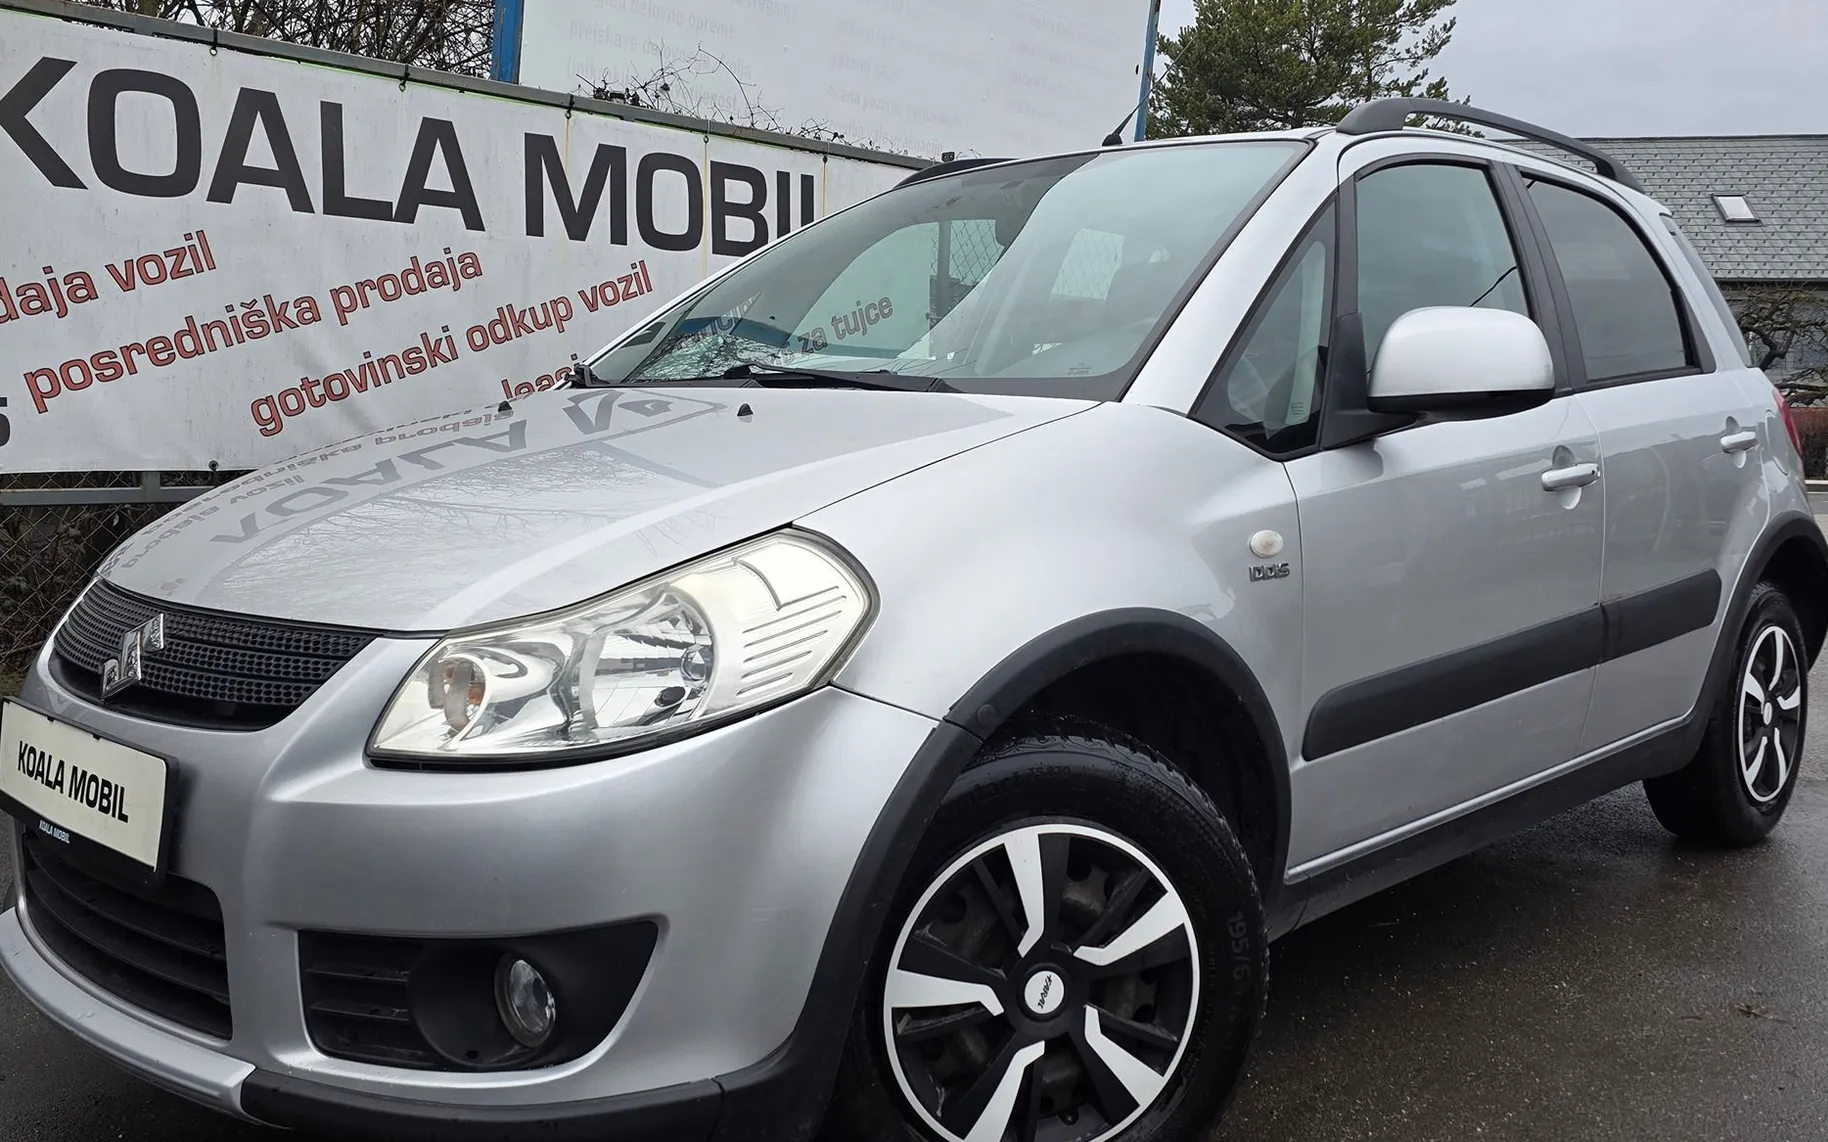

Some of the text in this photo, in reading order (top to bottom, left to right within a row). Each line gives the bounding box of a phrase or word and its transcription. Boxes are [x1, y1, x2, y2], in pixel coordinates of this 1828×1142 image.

[105, 230, 216, 292] vozil
[24, 247, 483, 413] posredniška prodaja
[250, 260, 654, 437] gotovinski odkup vozil
[798, 296, 893, 354] za tujce
[17, 740, 129, 823] KOALA MOBIL
